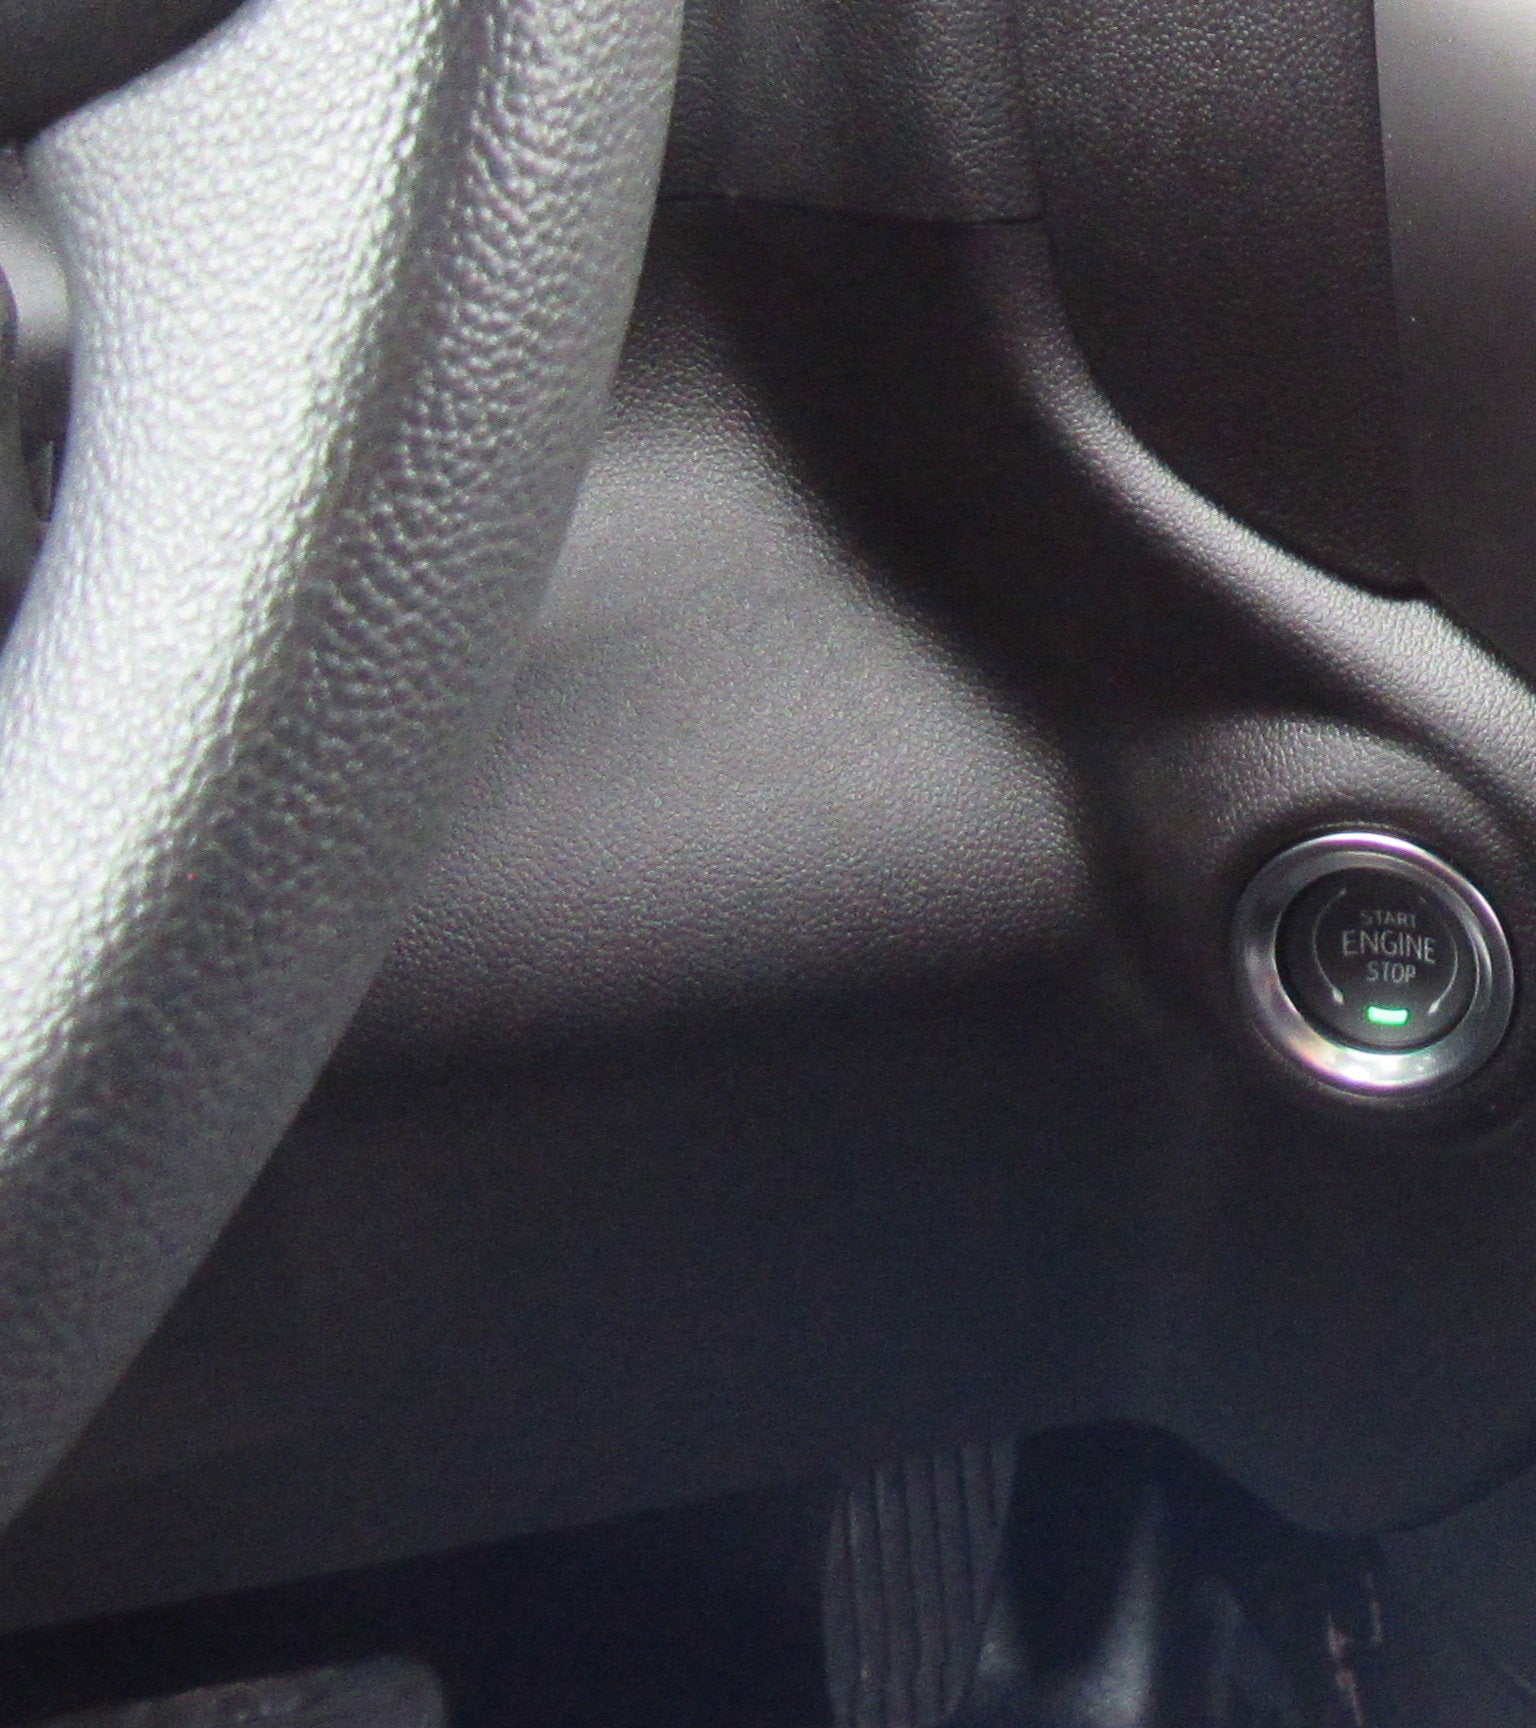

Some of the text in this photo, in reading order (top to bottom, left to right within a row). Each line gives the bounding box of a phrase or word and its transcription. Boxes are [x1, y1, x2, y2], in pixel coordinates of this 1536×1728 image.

[1359, 910, 1417, 928] START
[1341, 930, 1436, 964] ENGINE
[1366, 960, 1416, 984] STOP
